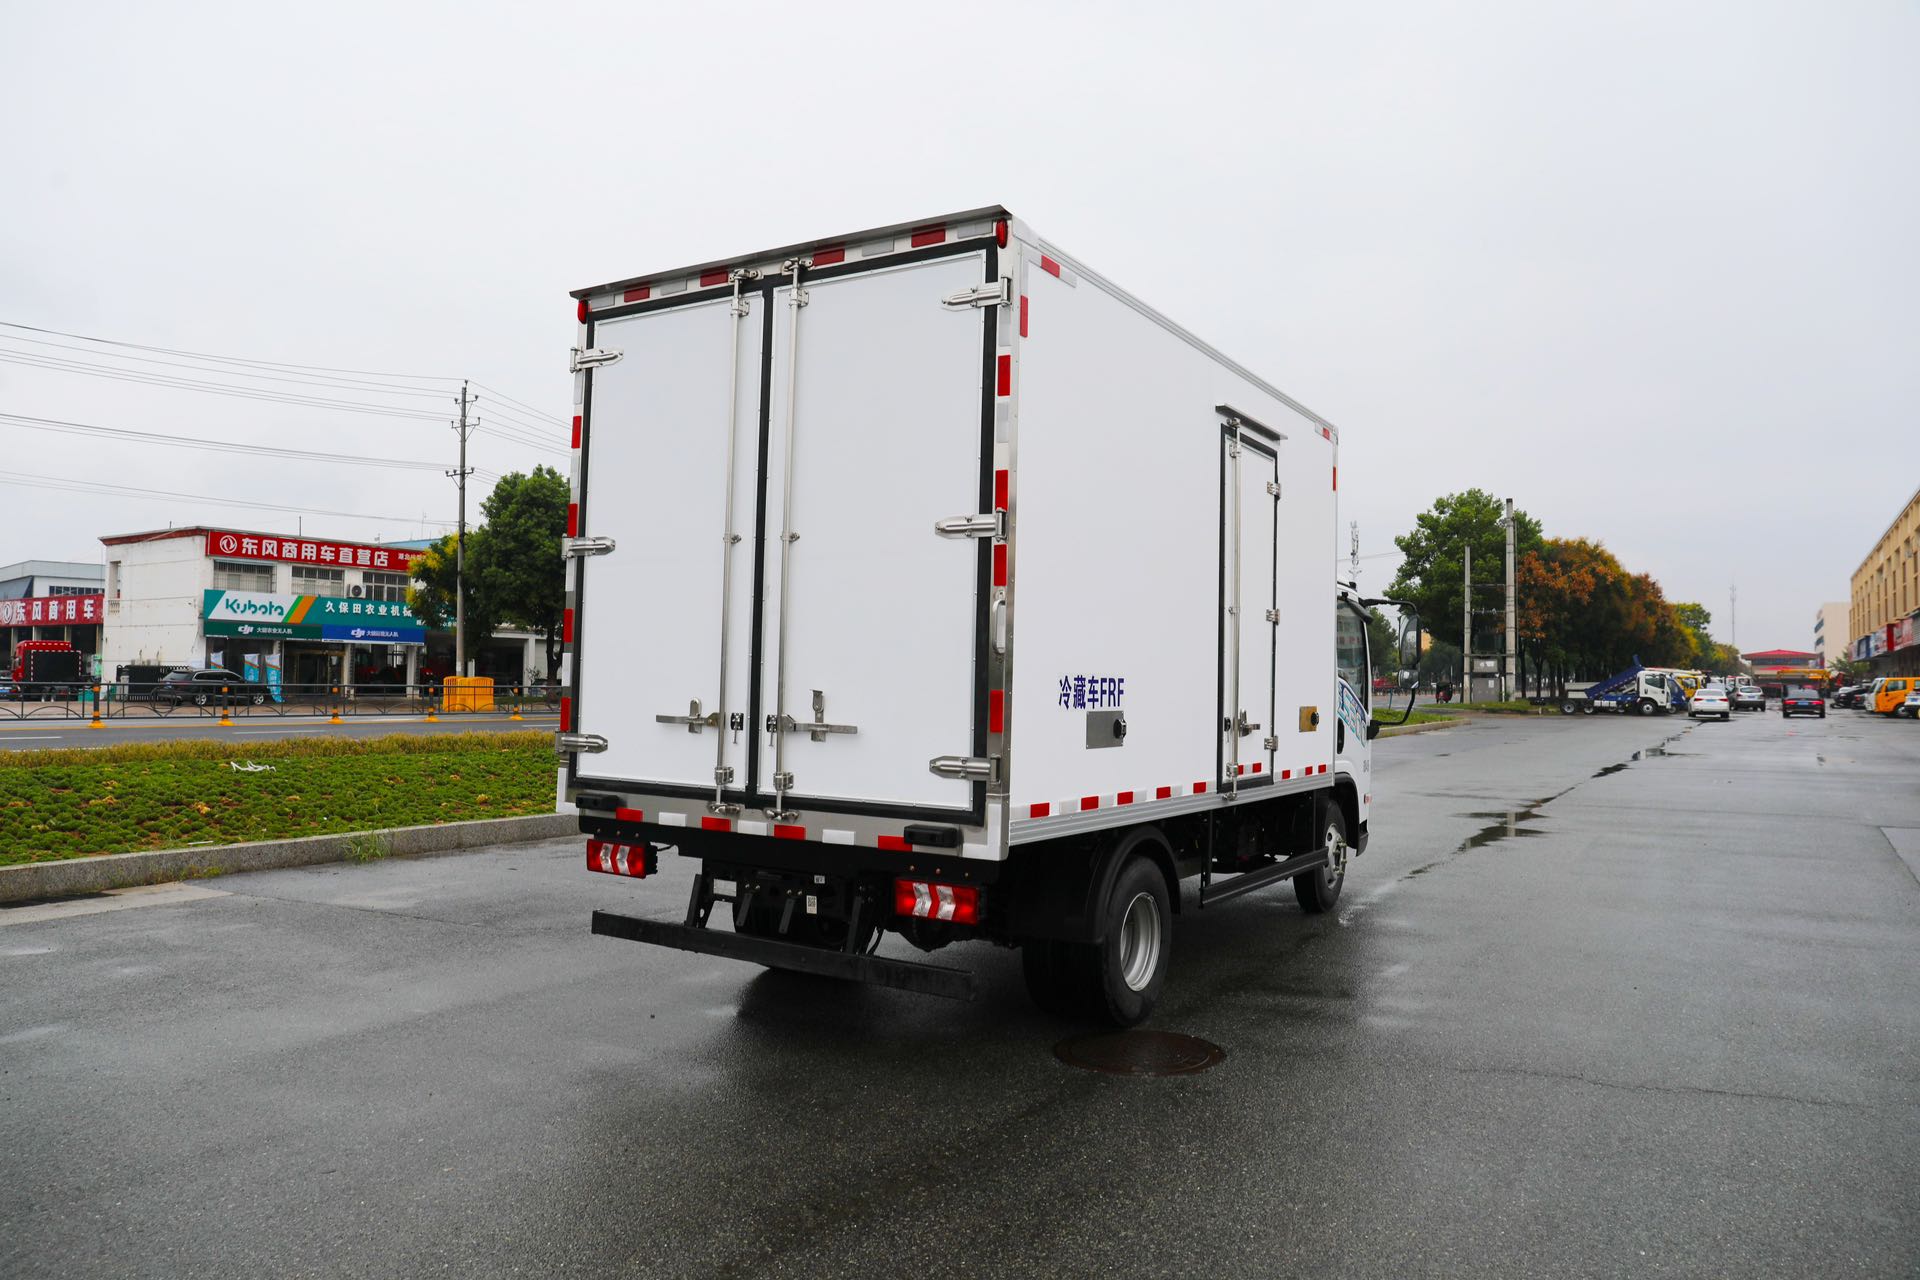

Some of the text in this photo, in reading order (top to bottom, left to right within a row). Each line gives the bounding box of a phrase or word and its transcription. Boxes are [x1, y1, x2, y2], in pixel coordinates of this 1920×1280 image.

[241, 537, 389, 567] 东风商用车直营店
[16, 599, 94, 621] 东风商用车
[225, 598, 285, 616] Kubota
[1058, 674, 1125, 710] 冷藏车FRF
